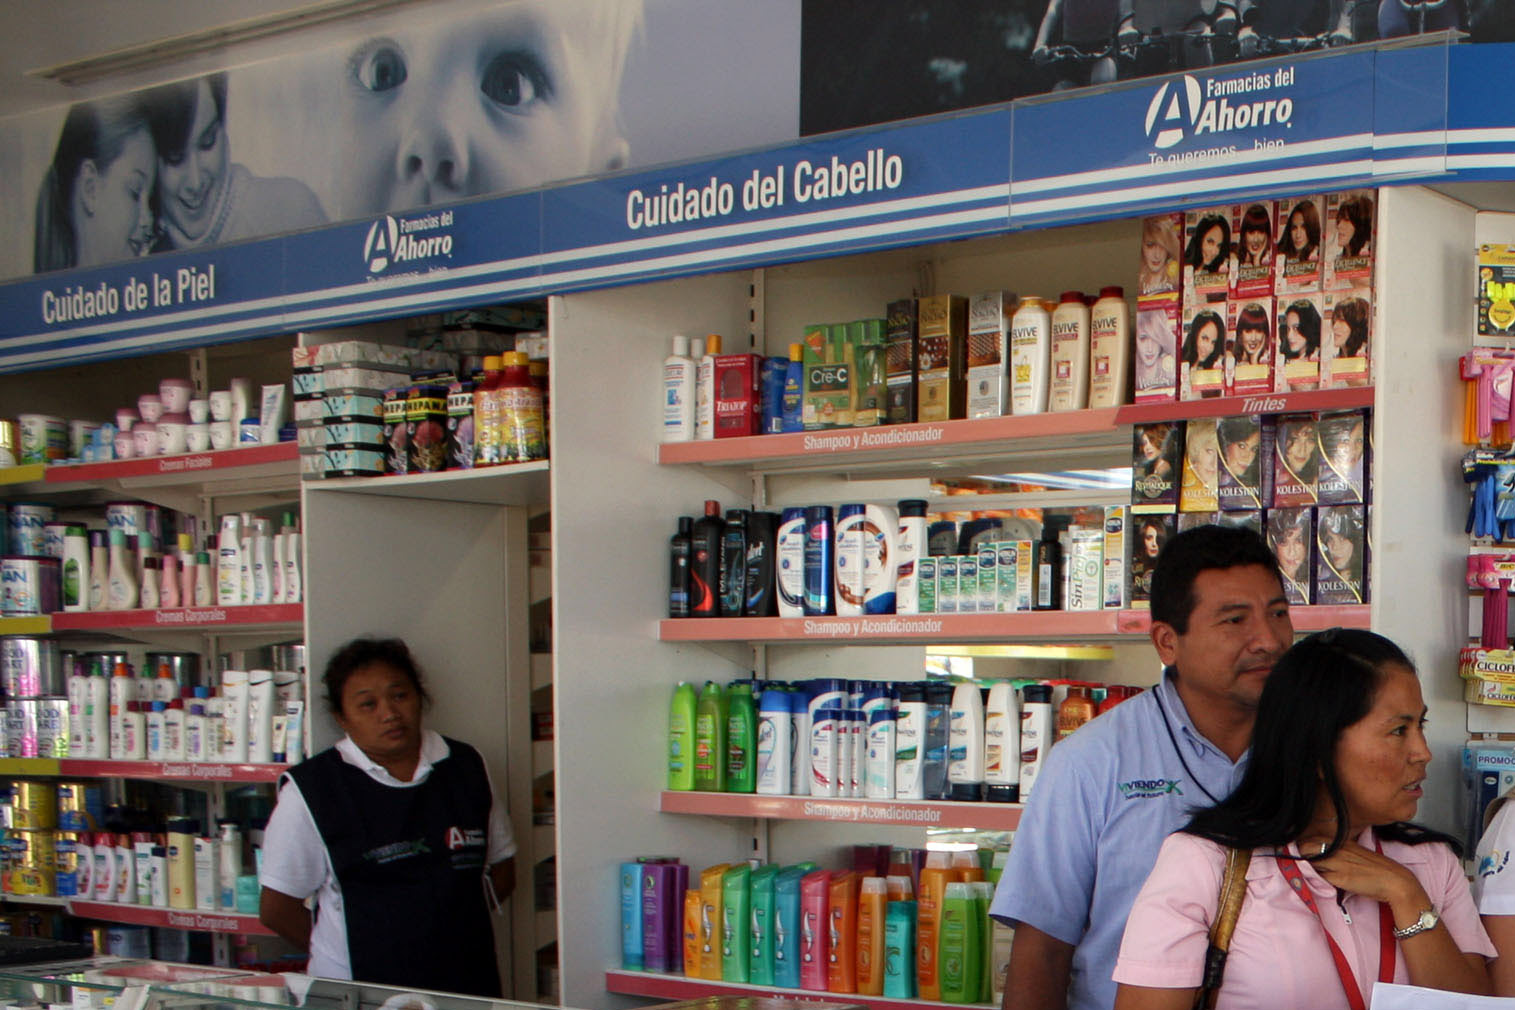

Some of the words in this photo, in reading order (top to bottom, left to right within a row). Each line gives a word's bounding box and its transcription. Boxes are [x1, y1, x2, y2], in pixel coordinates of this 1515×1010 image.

[1207, 72, 1271, 98] Farmacias
[1274, 66, 1294, 87] del
[626, 171, 735, 230] Cuidado
[742, 163, 785, 210] del
[792, 149, 903, 204] Cabello
[401, 215, 438, 235] Farmacias
[440, 210, 454, 228] del
[42, 282, 118, 325] Cuidado
[124, 278, 148, 311] de
[153, 273, 171, 306] la
[178, 264, 215, 302] Piel
[811, 367, 848, 384] Cre-C
[1241, 398, 1287, 413] Tintes
[804, 433, 851, 454] Shampoo
[853, 437, 861, 450] y
[861, 426, 944, 447] Acondicionador
[1219, 485, 1259, 498] KOLESTON
[1276, 485, 1318, 495] KOLESTON
[1319, 480, 1361, 492] KOLESTON
[1318, 581, 1360, 593] KOLESTON
[804, 619, 850, 637] Shampoo
[852, 623, 859, 635] y
[861, 618, 943, 635] Acondicionador
[804, 802, 850, 818] Shampoo
[852, 806, 860, 819] y
[861, 805, 942, 823] Acondicionador
